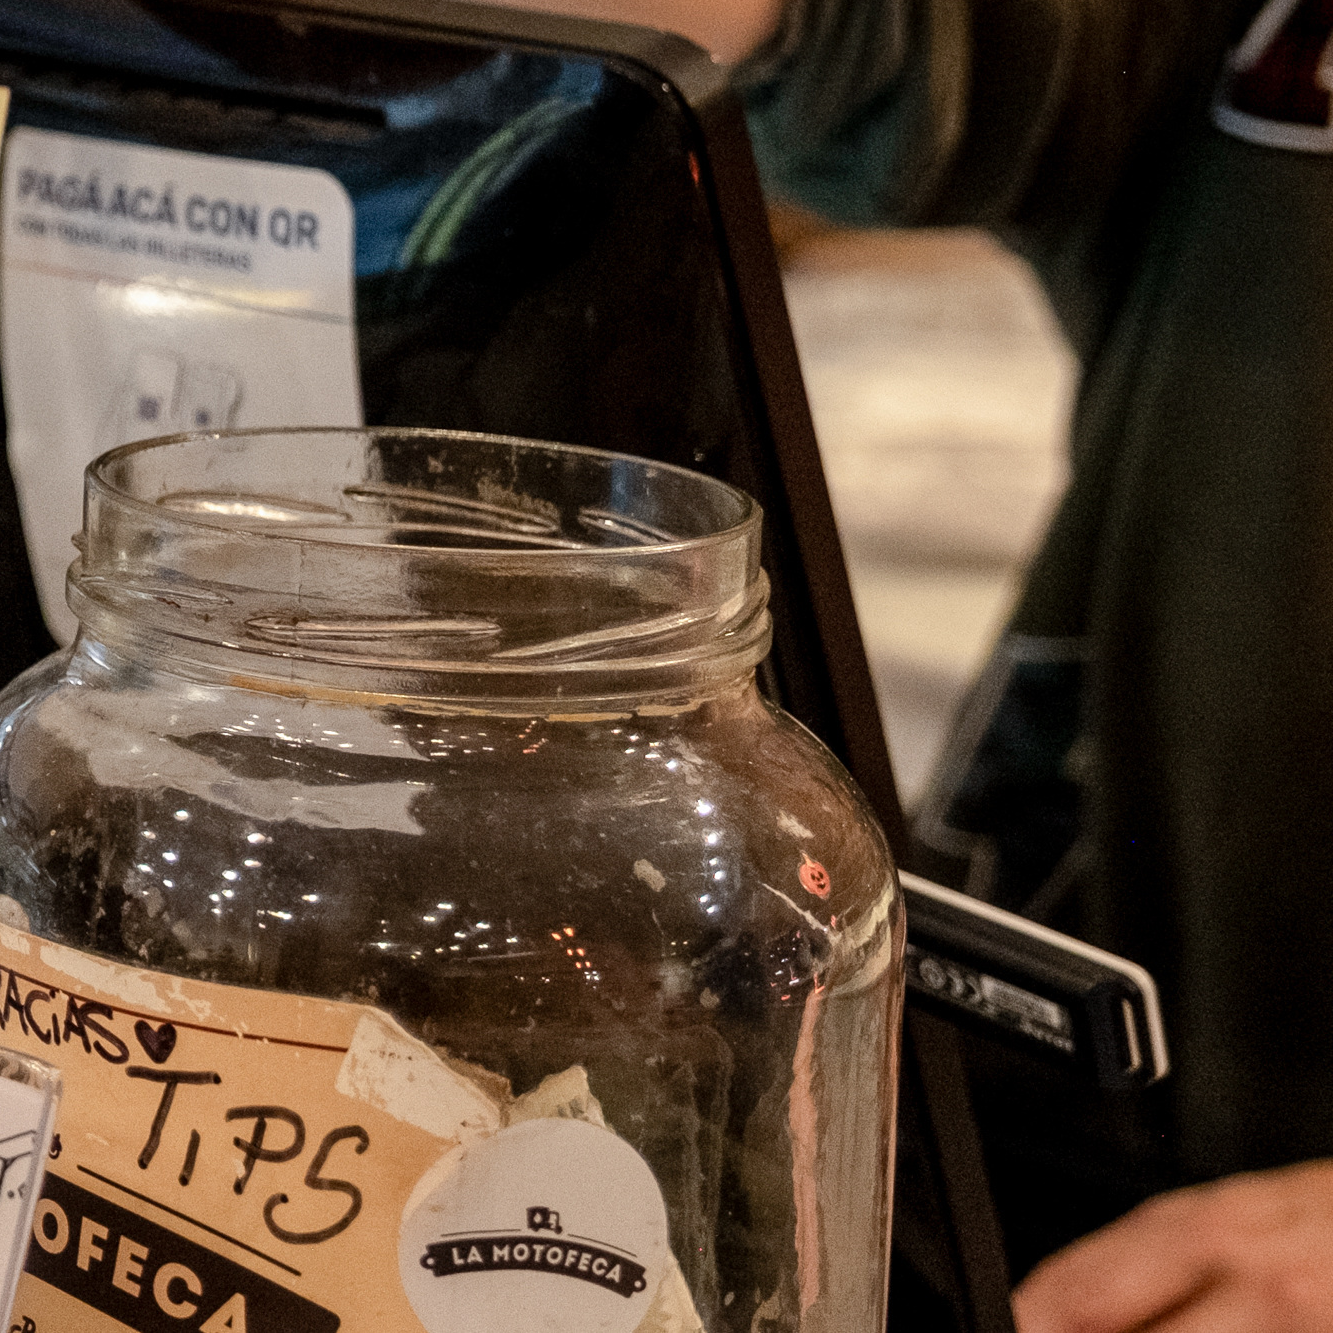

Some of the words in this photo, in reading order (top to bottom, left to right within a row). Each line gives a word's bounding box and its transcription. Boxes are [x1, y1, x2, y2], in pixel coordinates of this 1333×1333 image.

[18, 168, 102, 214] PAGÁ
[110, 182, 177, 226] ACÁ
[186, 193, 259, 241] CON
[269, 207, 321, 251] QR
[451, 1245, 484, 1266] LA
[492, 1243, 622, 1284] MOTOFECA
